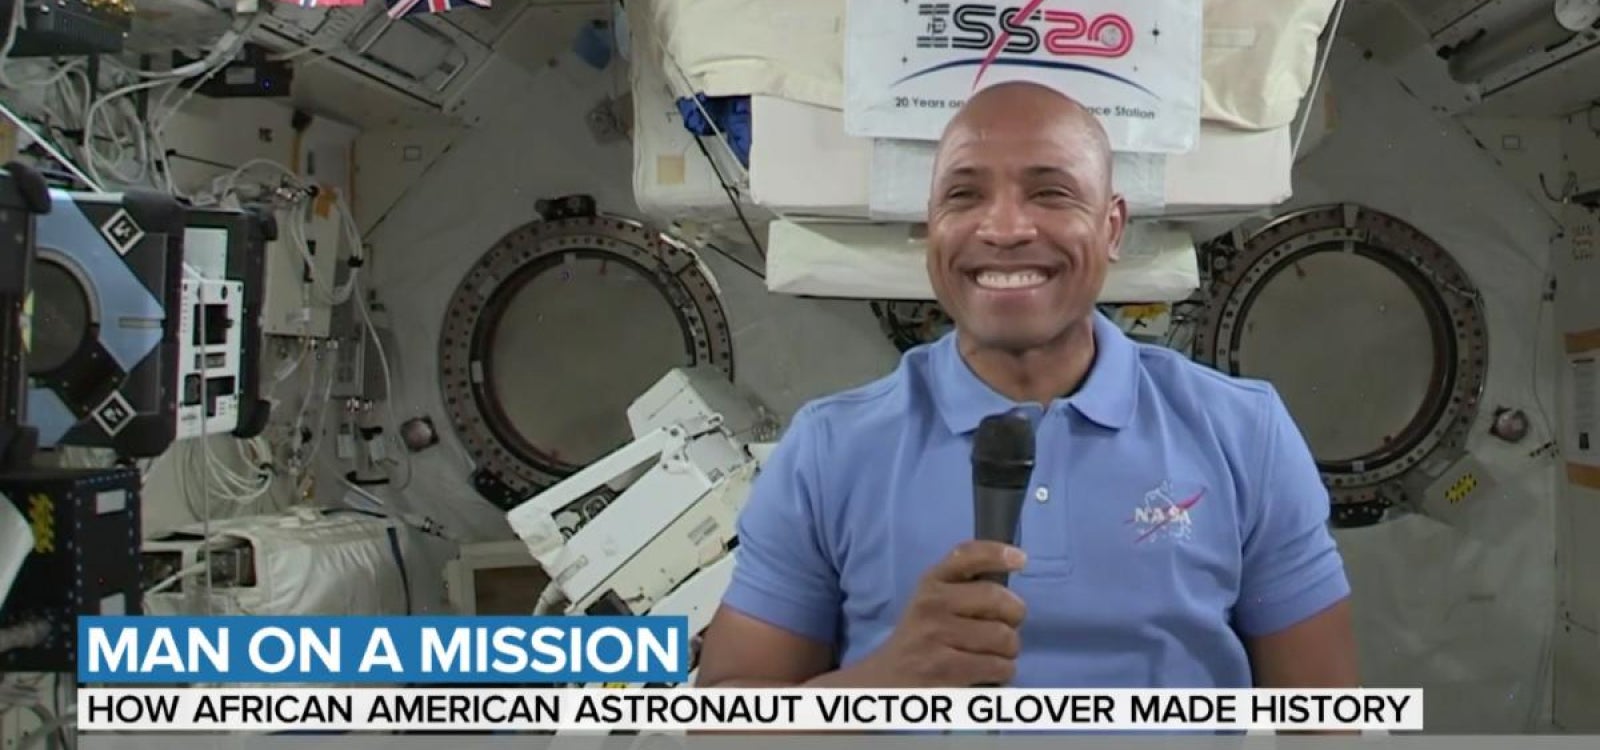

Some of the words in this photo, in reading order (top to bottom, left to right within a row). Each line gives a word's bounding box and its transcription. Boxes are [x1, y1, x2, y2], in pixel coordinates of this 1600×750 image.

[895, 96, 908, 108] 20
[912, 97, 945, 108] Years
[1085, 106, 1111, 116] ace
[1115, 105, 1155, 119] Station
[1135, 506, 1192, 524] NASA
